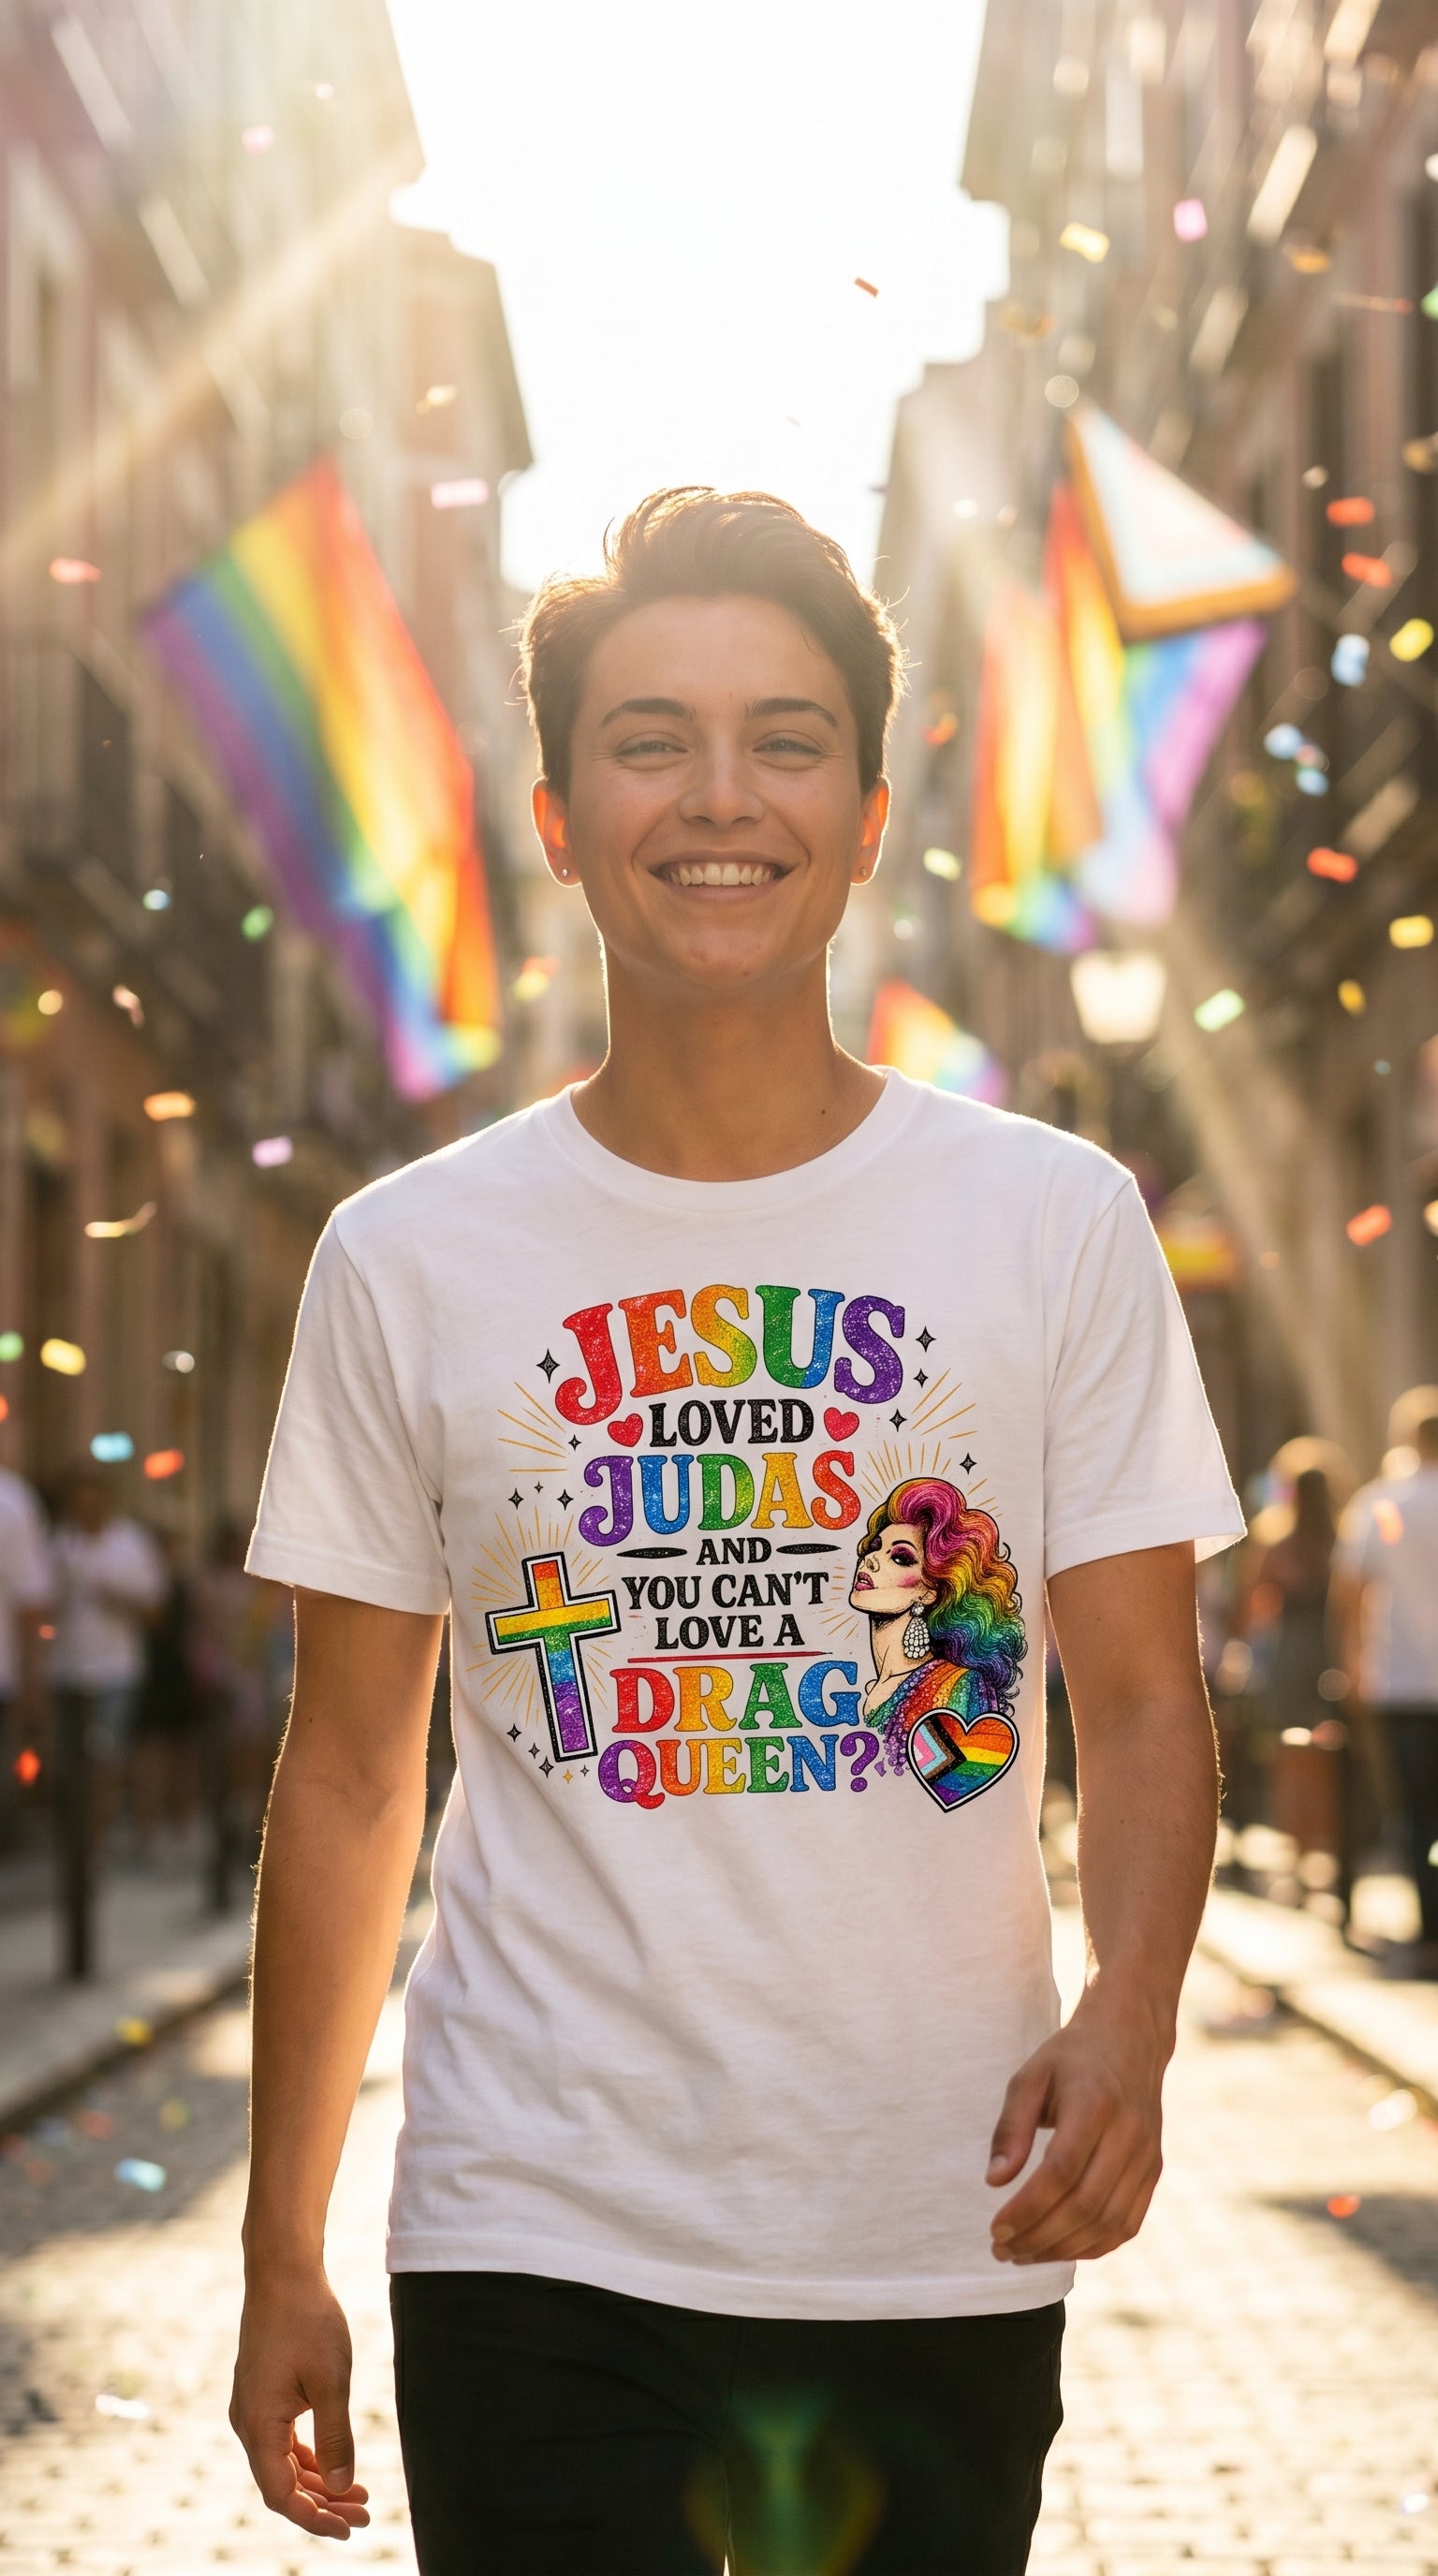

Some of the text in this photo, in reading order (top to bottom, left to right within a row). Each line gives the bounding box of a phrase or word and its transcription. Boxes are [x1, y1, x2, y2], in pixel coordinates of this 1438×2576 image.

[555, 1284, 905, 1426] JESUS
[649, 1398, 814, 1447] LOVED
[578, 1450, 861, 1546] JUDAS
[696, 1537, 772, 1566] AND
[622, 1571, 829, 1611] YOU CAN'T
[654, 1613, 805, 1650] LOVE A
[609, 1660, 862, 1734] DRAG
[597, 1731, 880, 1809] QUEEN?
